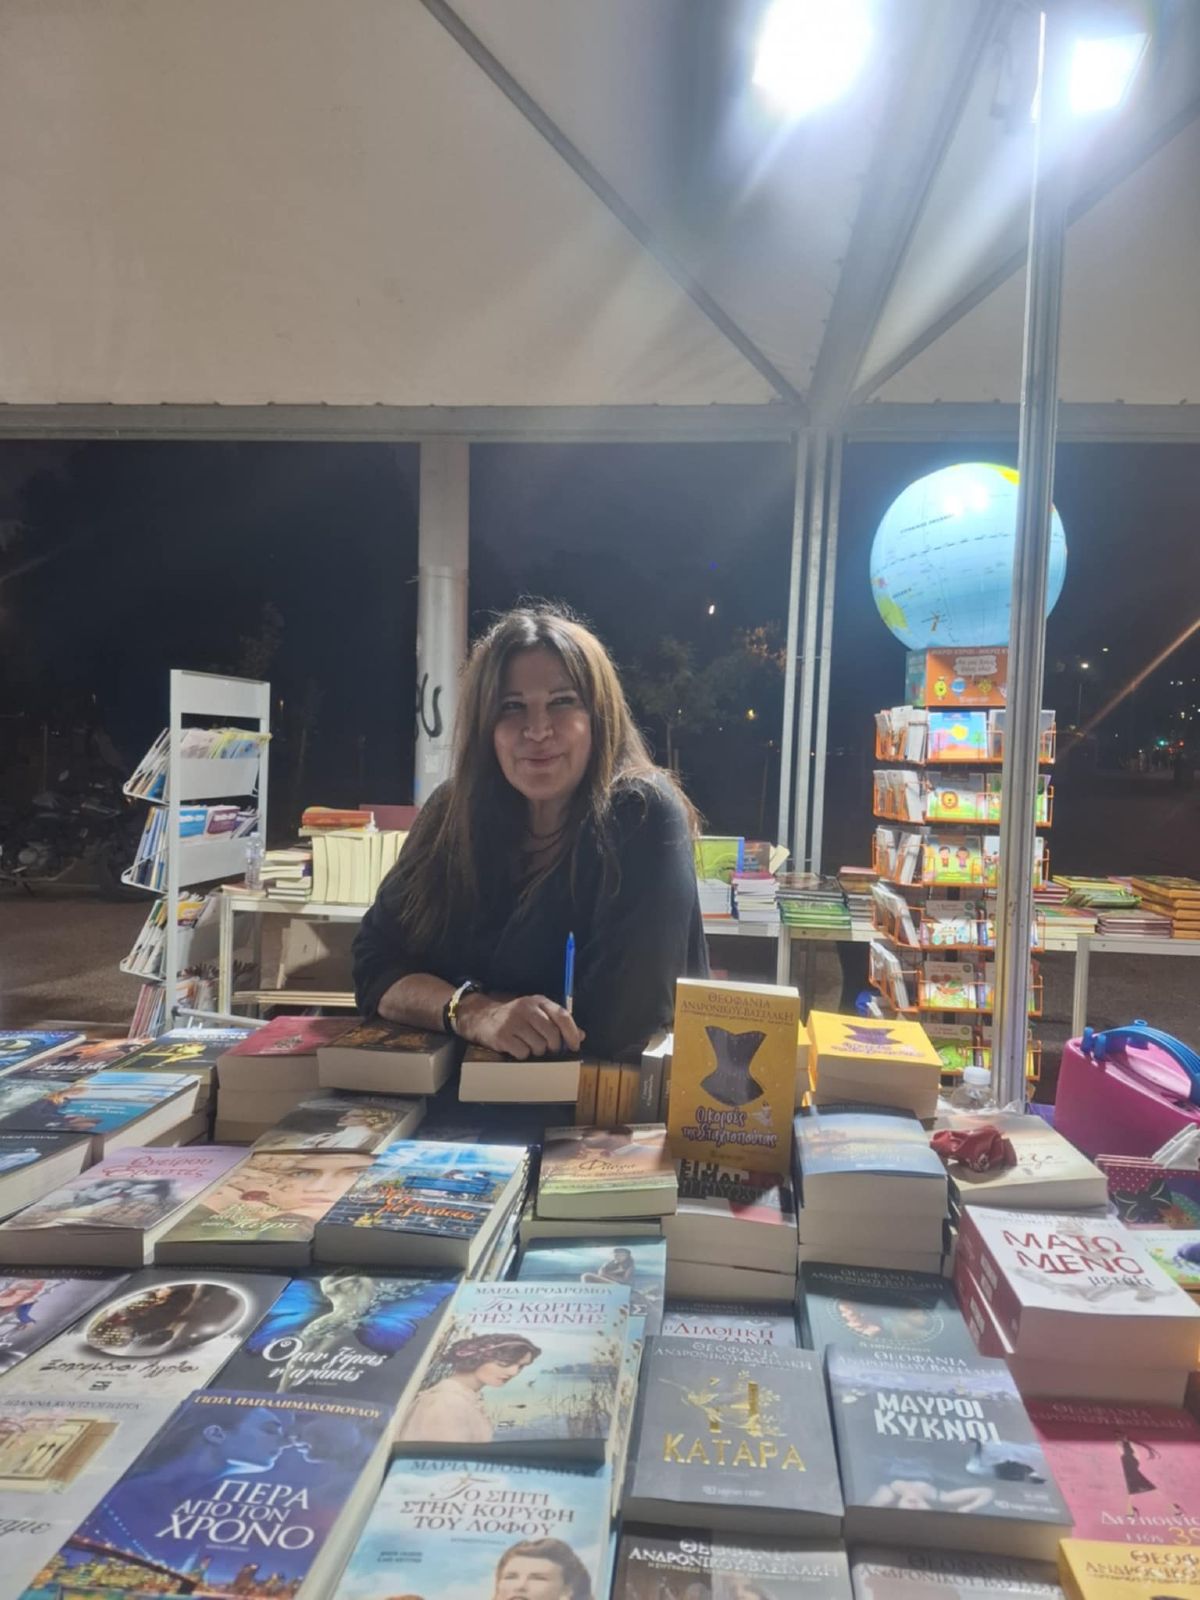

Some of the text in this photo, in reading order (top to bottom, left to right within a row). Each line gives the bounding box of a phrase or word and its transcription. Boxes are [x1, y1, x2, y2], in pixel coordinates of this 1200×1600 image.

[707, 992, 771, 1009] ΘΕΟΦΑΝΙΑ
[1002, 1230, 1127, 1253] ΜΑΤΩ
[1016, 1250, 1145, 1275] ΜΕΝΟ
[475, 1286, 520, 1295] ΜΑΡΙΑ
[519, 1301, 606, 1313] ΚΟΡΙΤΣΙ
[468, 1313, 607, 1325] ΤΗΣ ΛΙΜΝΗΣ
[692, 1342, 780, 1358] ΘΕΟΦΑΝΙΑ
[874, 1351, 968, 1367] ΘΕΟΦΑΝΙΑ
[235, 1397, 383, 1419] ΠΑΠΑΔΗΜΑΚΟΠΟΥΛΟΥ
[876, 1391, 985, 1419] ΜΑΥΡΟΙ
[873, 1408, 1002, 1445] ΚΥΚΝΟΙ
[663, 1432, 807, 1472] ΚΑΤΑΡΑ
[410, 1460, 471, 1471] ΜΑΡΙΑ
[212, 1479, 310, 1510] ΠΕΡΑ
[487, 1489, 551, 1506] ΣΠΙΤΙ
[173, 1499, 291, 1523] ΑΠΟ ΤΟΝ
[400, 1500, 575, 1523] ΣΤΗΝ ΚΟΡΥΦΗ
[155, 1514, 315, 1550] ΧΡΟΝΟ
[413, 1516, 555, 1536] ΤΟΥ ΛΟΦΟΥ
